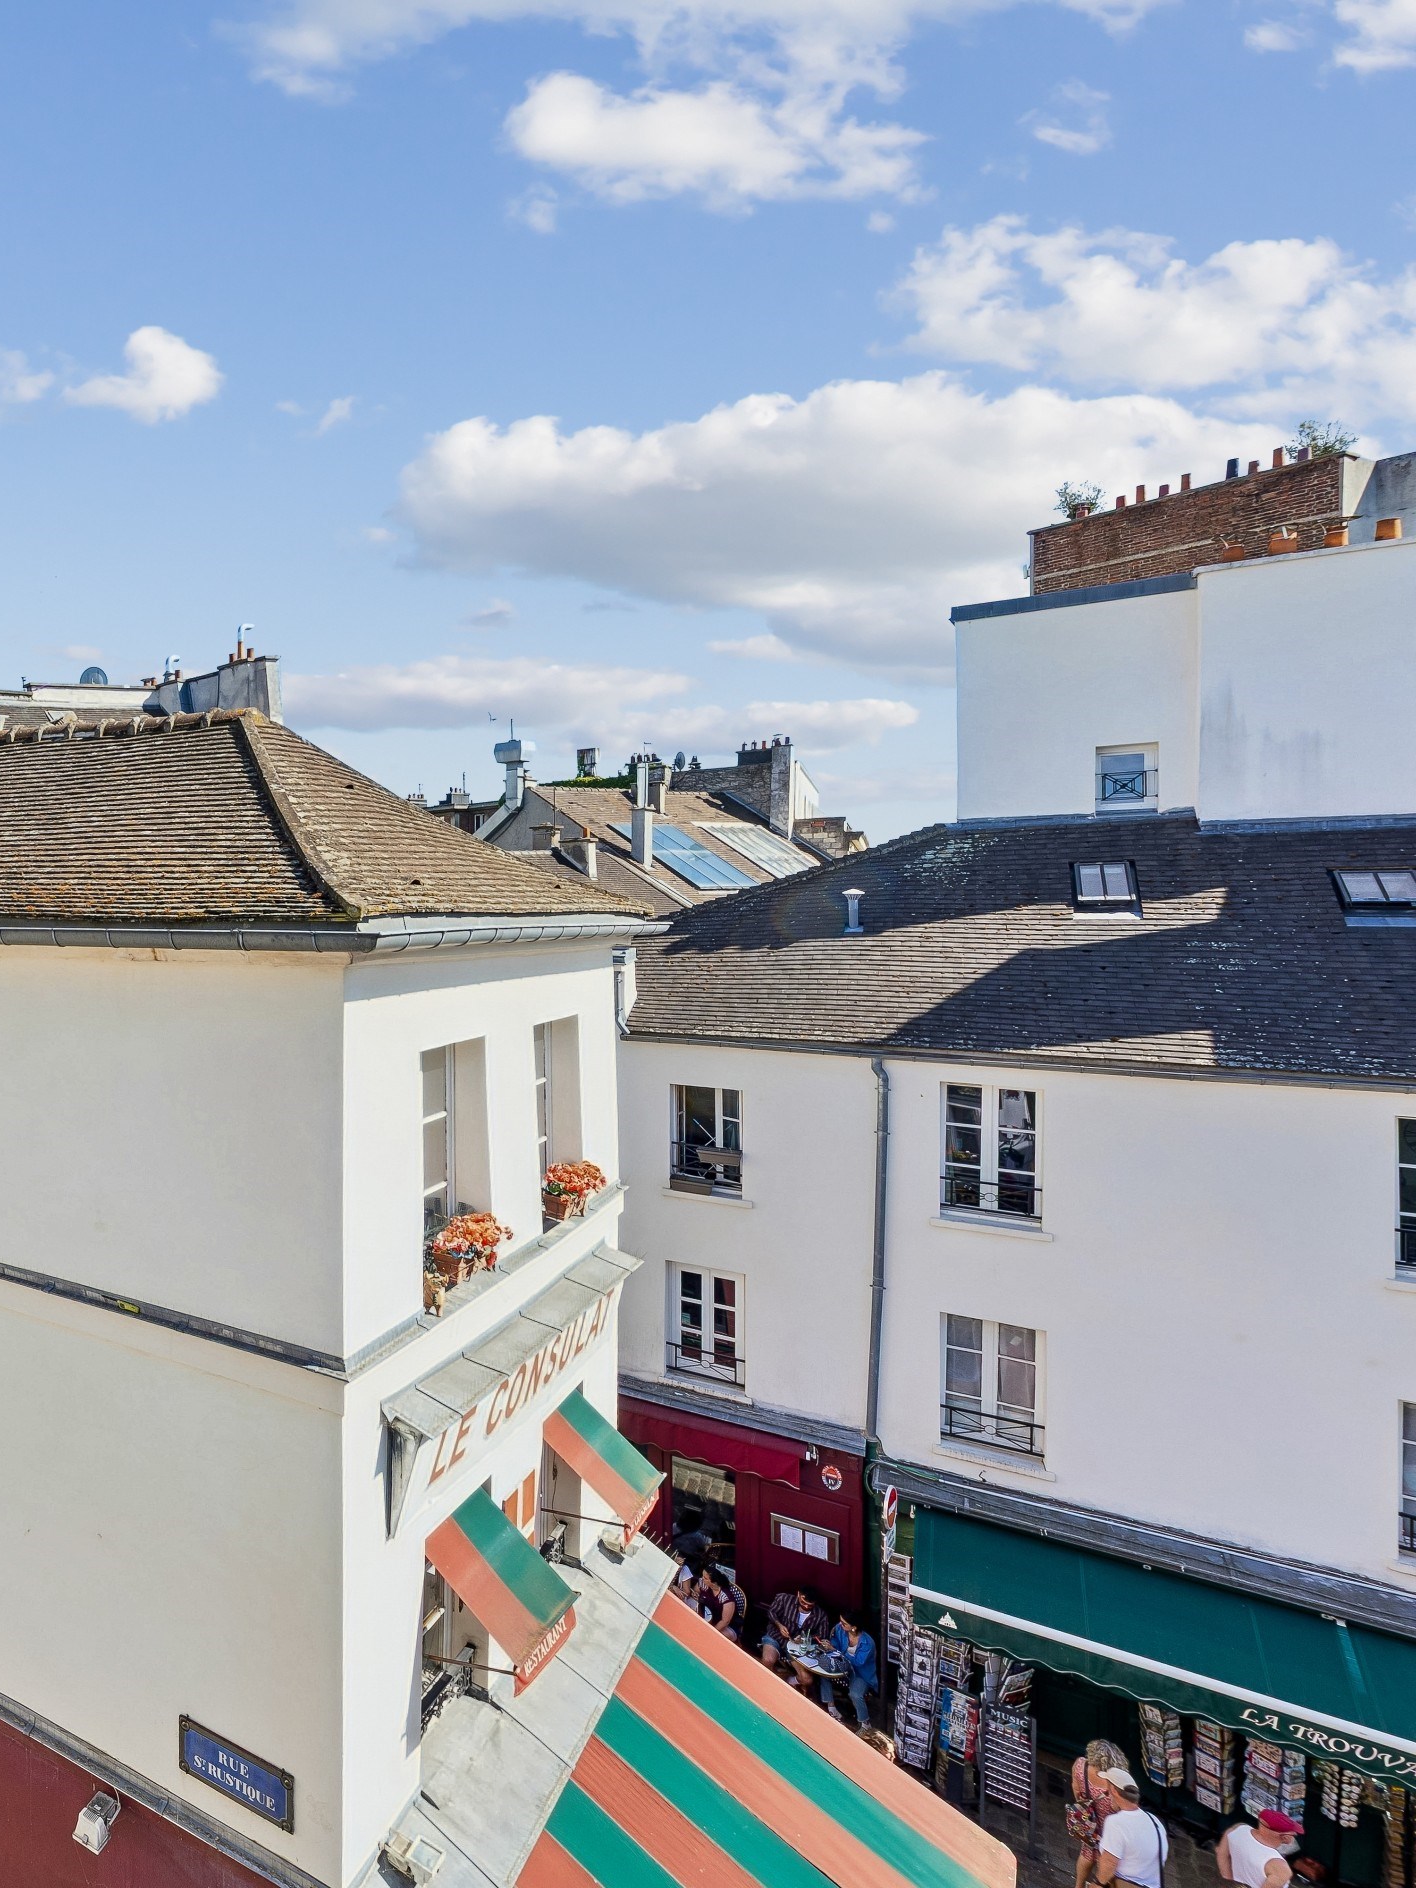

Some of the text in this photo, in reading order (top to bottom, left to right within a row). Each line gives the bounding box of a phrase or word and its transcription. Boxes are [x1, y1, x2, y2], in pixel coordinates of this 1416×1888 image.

[428, 1289, 614, 1485] LE CONSULAT
[523, 1615, 567, 1678] RESTAURANT
[990, 1708, 1029, 1728] MUSIC
[1239, 1708, 1281, 1731] LA
[218, 1750, 249, 1779] RUE
[208, 1763, 276, 1811] RUSTIQUE
